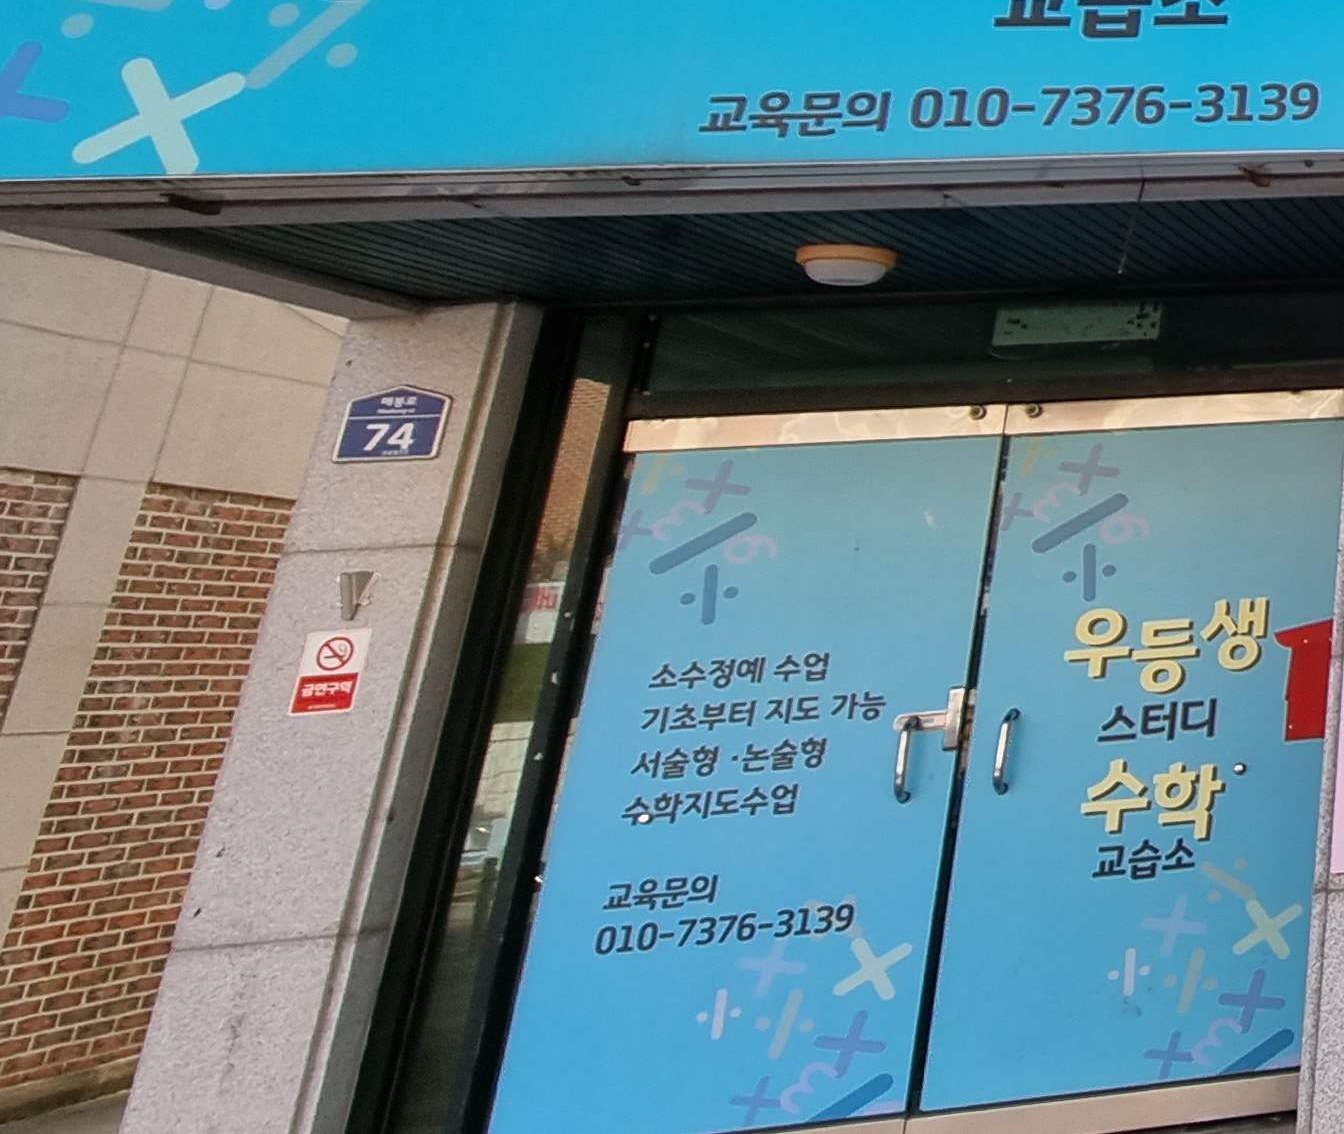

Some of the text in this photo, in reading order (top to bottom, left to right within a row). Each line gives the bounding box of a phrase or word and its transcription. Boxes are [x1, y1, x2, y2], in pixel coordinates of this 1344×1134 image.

[698, 81, 1321, 139] 교육문의 010-7376-3139
[363, 422, 416, 452] 74
[1064, 597, 1270, 695] 우등생
[648, 652, 830, 690] 소수정예 수업
[640, 691, 887, 734] 기초부터 지도 가능
[1098, 698, 1218, 744] 스터디
[630, 745, 720, 780] 서술형
[621, 783, 799, 826] 수학지도수업
[1081, 757, 1225, 841] 수학
[1092, 838, 1197, 881] 교습소
[602, 874, 719, 911] 교육문의
[595, 903, 856, 956] 010-7376-3139
